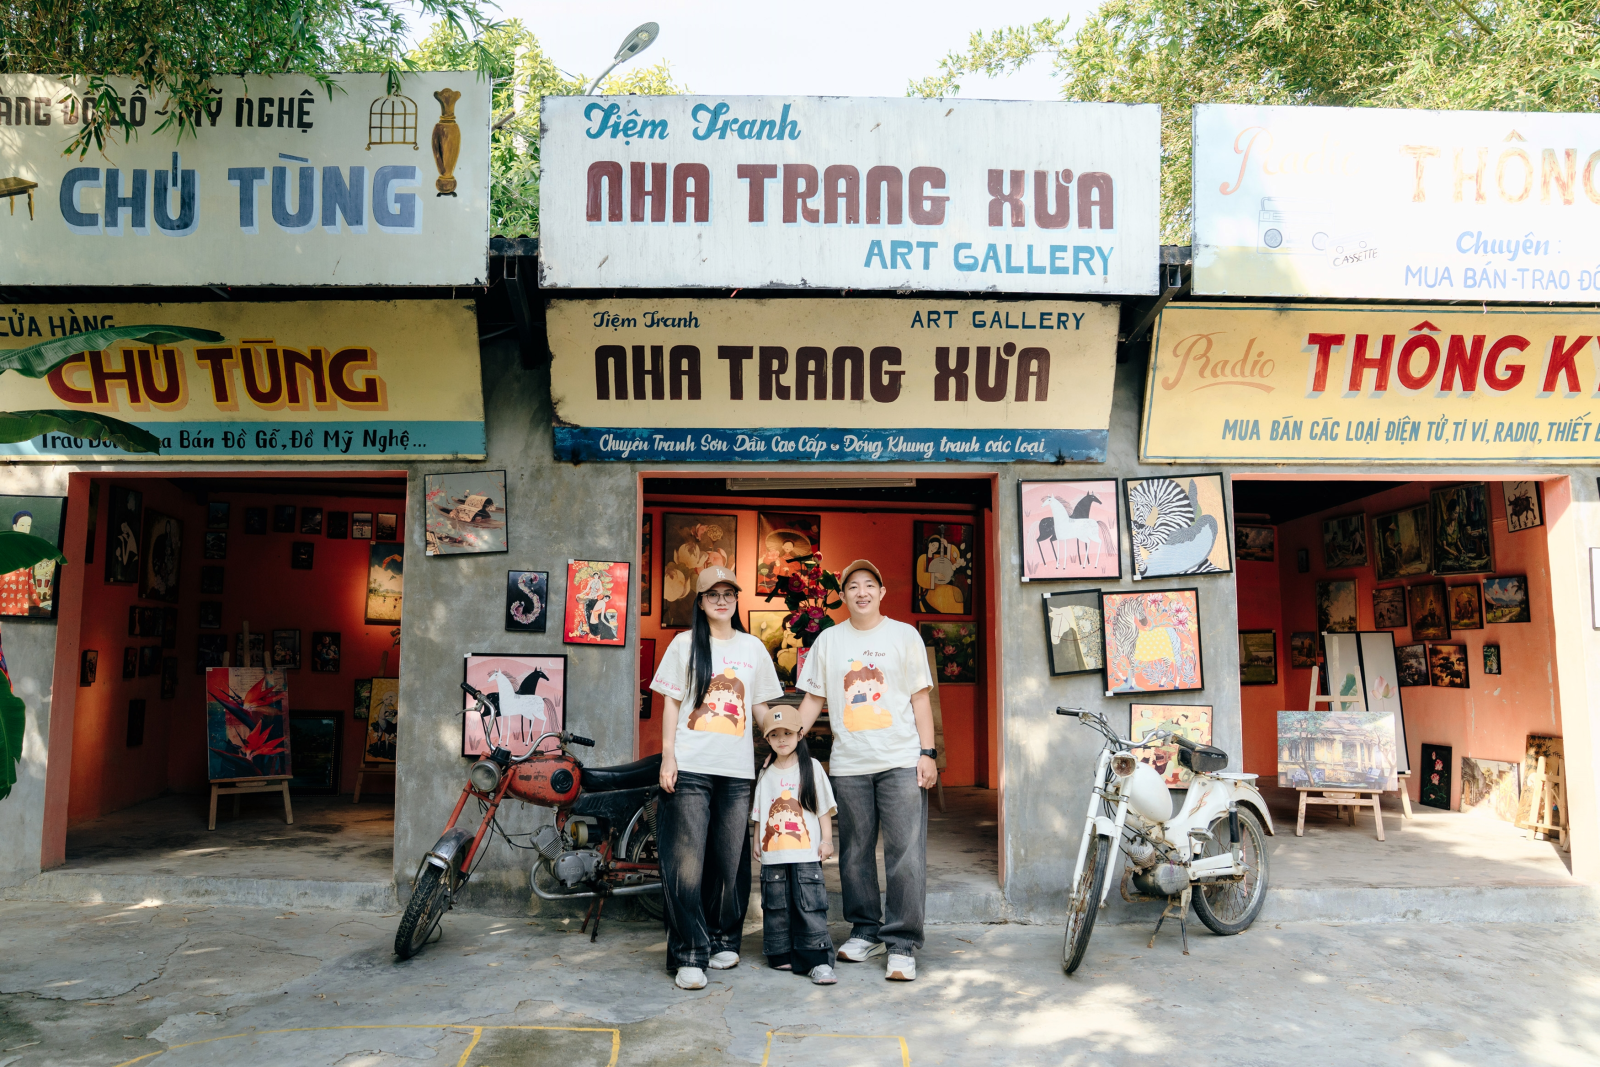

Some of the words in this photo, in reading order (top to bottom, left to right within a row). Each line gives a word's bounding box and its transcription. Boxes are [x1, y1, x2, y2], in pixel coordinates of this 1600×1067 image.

[236, 89, 315, 133] NGHỆ
[584, 103, 669, 146] Tiệm
[691, 102, 801, 140] Tranh
[228, 153, 421, 233] TÙNG
[586, 161, 711, 224] NHA
[737, 164, 951, 226] TRANG
[988, 168, 1116, 230] XƯA
[864, 240, 938, 270] ART
[953, 242, 1114, 276] GALLERY
[1333, 248, 1378, 267] CASSETTE
[1405, 265, 1454, 288] MUA
[593, 311, 637, 331] Tiệm
[643, 311, 700, 328] Tranh
[911, 311, 958, 328] ART
[972, 311, 1085, 330] GALLERY
[595, 345, 701, 400] NHA
[718, 346, 905, 403] TRANG
[934, 342, 1050, 402] XƯA
[1162, 331, 1275, 391] Radio
[1305, 320, 1531, 395] THÔNG
[1540, 335, 1600, 394] K
[179, 429, 214, 449] Bán
[222, 428, 246, 449] Đồ
[324, 430, 352, 453] Mỹ
[1222, 419, 1261, 441] MUA
[1270, 415, 1303, 441] BÁN
[1309, 417, 1340, 441] CÁC
[1493, 421, 1542, 444] RADIO,
[1547, 412, 1592, 441] THIẾT
[600, 434, 650, 458] Chuyên
[653, 435, 696, 451] Tranh
[701, 434, 730, 451] Sơn
[733, 435, 767, 451] Dầu
[771, 436, 796, 452] Cao
[798, 434, 827, 459] Cấp
[843, 435, 883, 458] Đóng
[887, 436, 935, 458] Khung
[940, 436, 982, 453] tranh
[985, 436, 1011, 453] các
[1015, 437, 1046, 456] loại
[716, 568, 726, 579] LA
